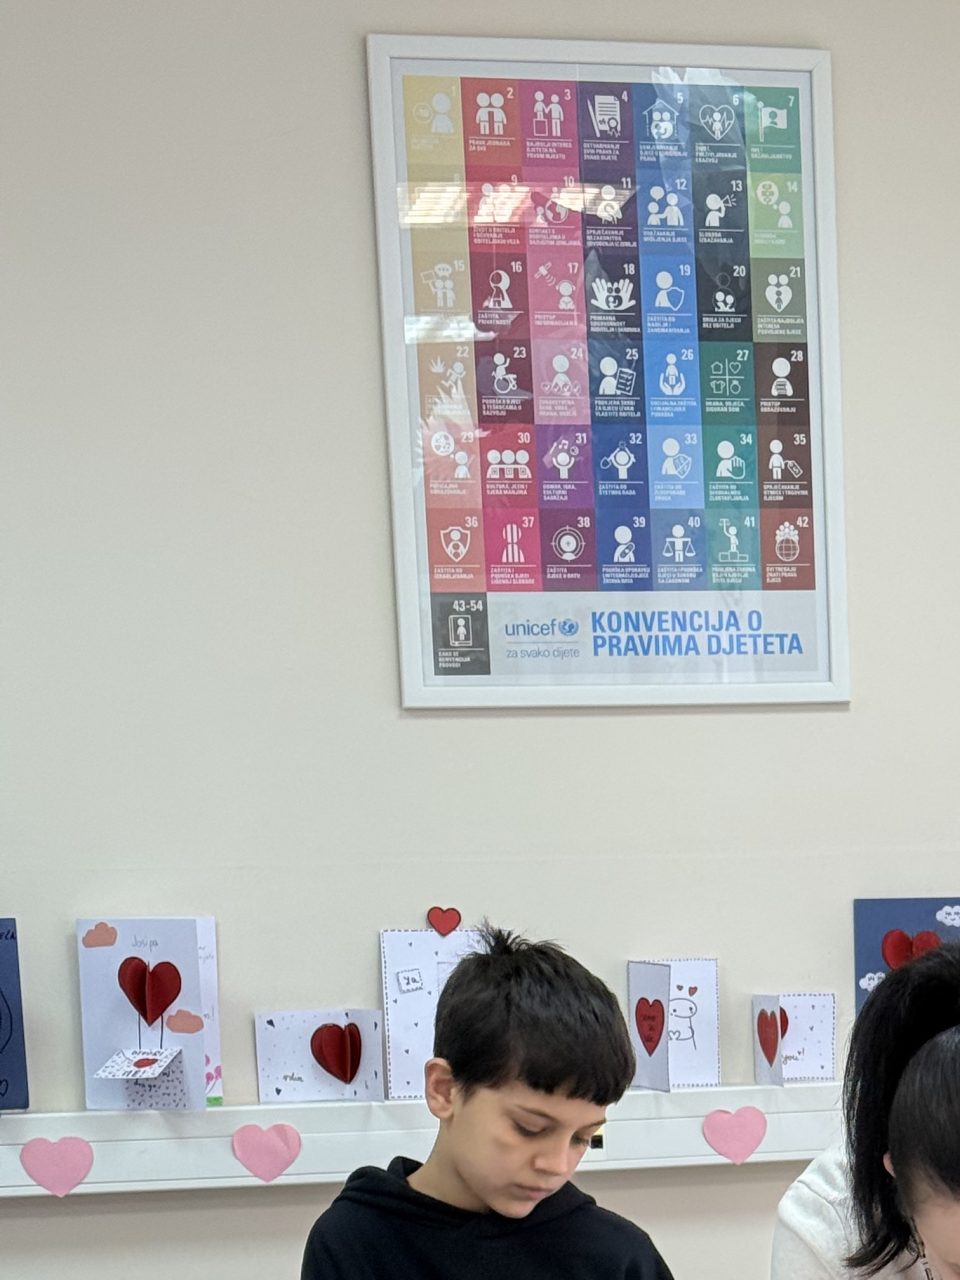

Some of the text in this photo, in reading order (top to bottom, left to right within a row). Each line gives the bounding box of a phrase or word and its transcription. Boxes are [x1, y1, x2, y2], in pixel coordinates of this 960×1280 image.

[506, 87, 514, 99] 2
[564, 89, 571, 100] 3
[621, 90, 628, 102] 4
[676, 92, 683, 104] 5
[732, 94, 739, 106] 6
[788, 96, 794, 108] 7
[510, 175, 517, 186] 9
[563, 176, 575, 188] 10
[621, 176, 631, 188] 11
[675, 178, 687, 191] 12
[731, 180, 742, 192] 13
[787, 180, 798, 193] 14
[453, 260, 465, 272] 15
[511, 261, 522, 273] 16
[567, 262, 579, 275] 17
[623, 264, 635, 276] 18
[679, 264, 690, 277] 19
[733, 265, 746, 278] 20
[790, 266, 801, 278] 21
[456, 346, 469, 358] 22
[514, 346, 526, 359] 23
[571, 347, 583, 359] 24
[626, 348, 639, 360] 25
[682, 349, 694, 361] 26
[736, 350, 749, 362] 27
[790, 350, 803, 362] 28
[461, 431, 473, 443] 29
[518, 432, 530, 444] 30
[575, 433, 587, 444] 31
[630, 433, 642, 445] 32
[685, 434, 697, 445] 33
[740, 434, 752, 445] 34
[794, 434, 806, 445] 35
[465, 516, 478, 528] 36
[522, 516, 534, 528] 37
[577, 517, 590, 528] 38
[633, 517, 646, 528] 39
[688, 517, 700, 528] 40
[744, 517, 756, 528] 41
[797, 516, 809, 527] 42
[453, 600, 483, 611] 43-54
[505, 619, 556, 636] unicef
[591, 610, 762, 633] KONVENCIJA O
[593, 633, 803, 657] PRAVIMA DJETETA
[506, 648, 580, 660] za svako dijete
